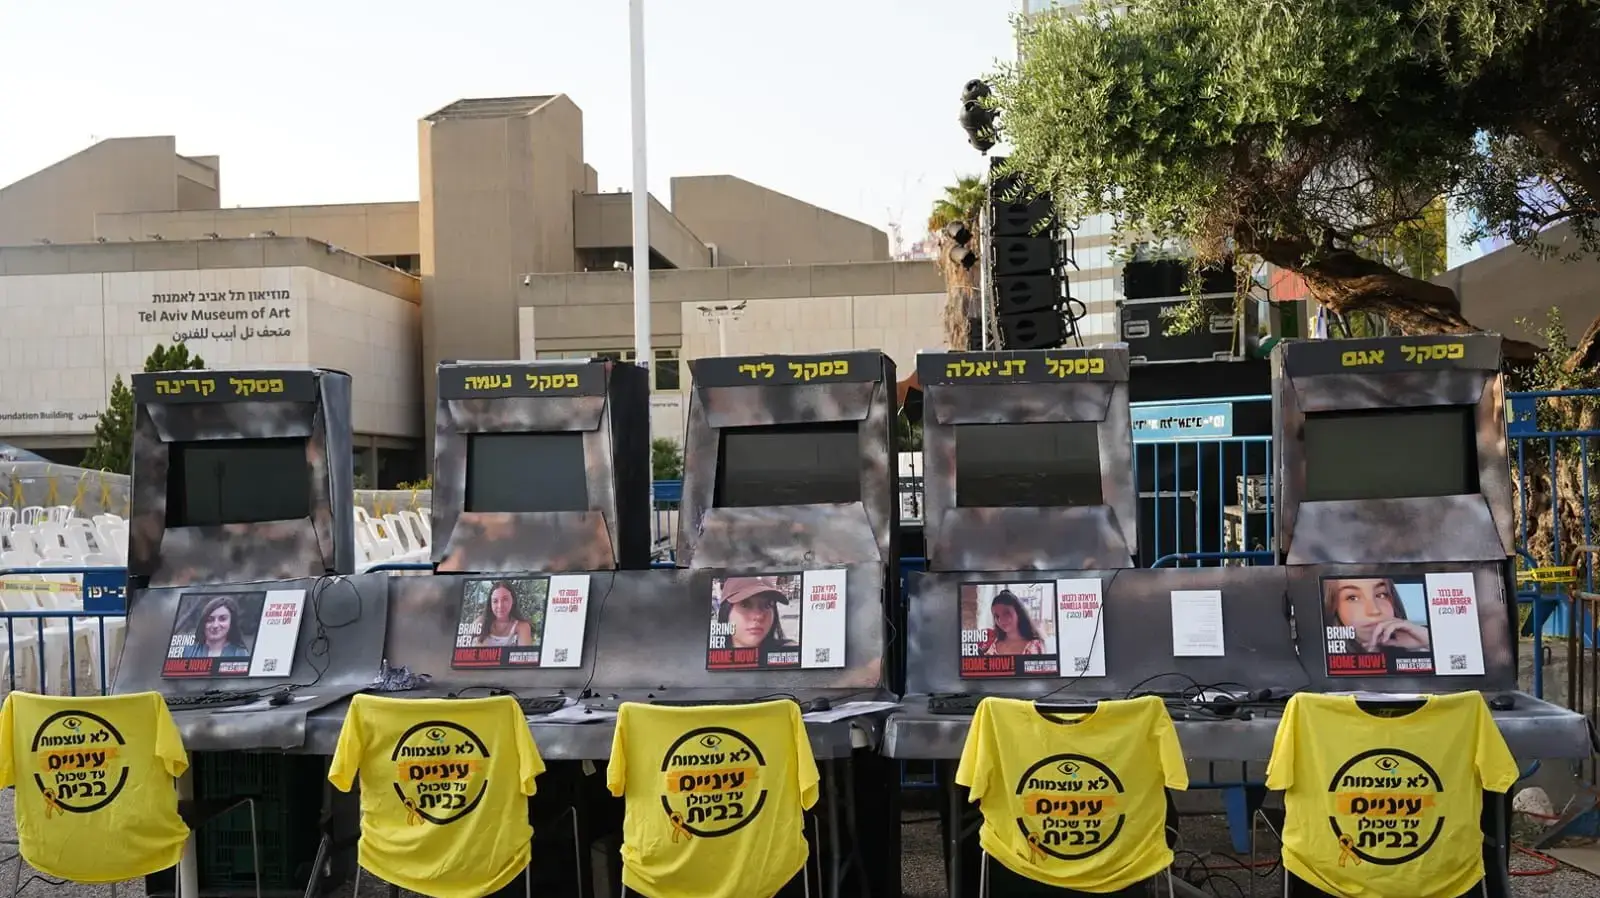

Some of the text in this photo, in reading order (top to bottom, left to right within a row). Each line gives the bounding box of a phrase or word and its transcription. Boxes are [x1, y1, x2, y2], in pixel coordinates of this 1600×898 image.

[152, 289, 290, 303] מוזיאון תל אביב לאמנות
[138, 307, 290, 322] Tel Aviv Museum of Art
[172, 324, 291, 342] متحف تل أبيب للفنون
[1341, 344, 1464, 366] פסקל אגם
[738, 360, 849, 381] פסקל לירי
[946, 357, 1104, 378] פסקל דניאלה
[155, 377, 284, 396] פסקל קרינה
[464, 373, 579, 392] פסקל נעמה
[40, 410, 73, 421] Building
[1432, 597, 1472, 605] AGAM BERGER
[458, 623, 482, 635] BRING
[710, 623, 735, 636] BRING
[961, 629, 988, 643] BRING
[1326, 625, 1356, 640] BRING
[171, 635, 196, 646] BRING
[456, 635, 471, 647] HER
[709, 636, 726, 649] HER
[1327, 640, 1347, 654] HER
[168, 646, 185, 658] HER
[455, 649, 478, 661] HOME
[478, 648, 501, 661] NOW!
[709, 650, 733, 663] HOME
[734, 648, 759, 663] NOW!
[961, 643, 979, 656] HER
[165, 659, 189, 671] HOME
[188, 658, 213, 671] NOW!
[961, 657, 987, 671] HOME
[988, 656, 1015, 671] NOW!
[1329, 653, 1387, 669] HOME NOW!
[41, 729, 109, 746] לא עוצמות
[401, 741, 474, 757] לא עוצמות
[48, 752, 106, 770] עיניים
[671, 748, 750, 766] לא עוצמות
[55, 770, 105, 784] עד שכולן
[409, 763, 469, 780] עיניים
[417, 782, 467, 794] עד שכולן
[679, 771, 744, 791] עיניים
[1028, 776, 1109, 792] לא עוצמות
[1342, 773, 1429, 788] לא עוצמות
[58, 781, 107, 799] בבית
[419, 793, 466, 809] בבית
[686, 791, 743, 808] עד שכולן
[1036, 798, 1103, 816] עיניים
[1351, 797, 1422, 815] עיניים
[686, 802, 743, 823] בבית
[1043, 816, 1101, 830] עד שכולן
[1358, 816, 1419, 831] עד שכולן
[1043, 830, 1101, 846] בבית
[1356, 831, 1419, 848] בבית
